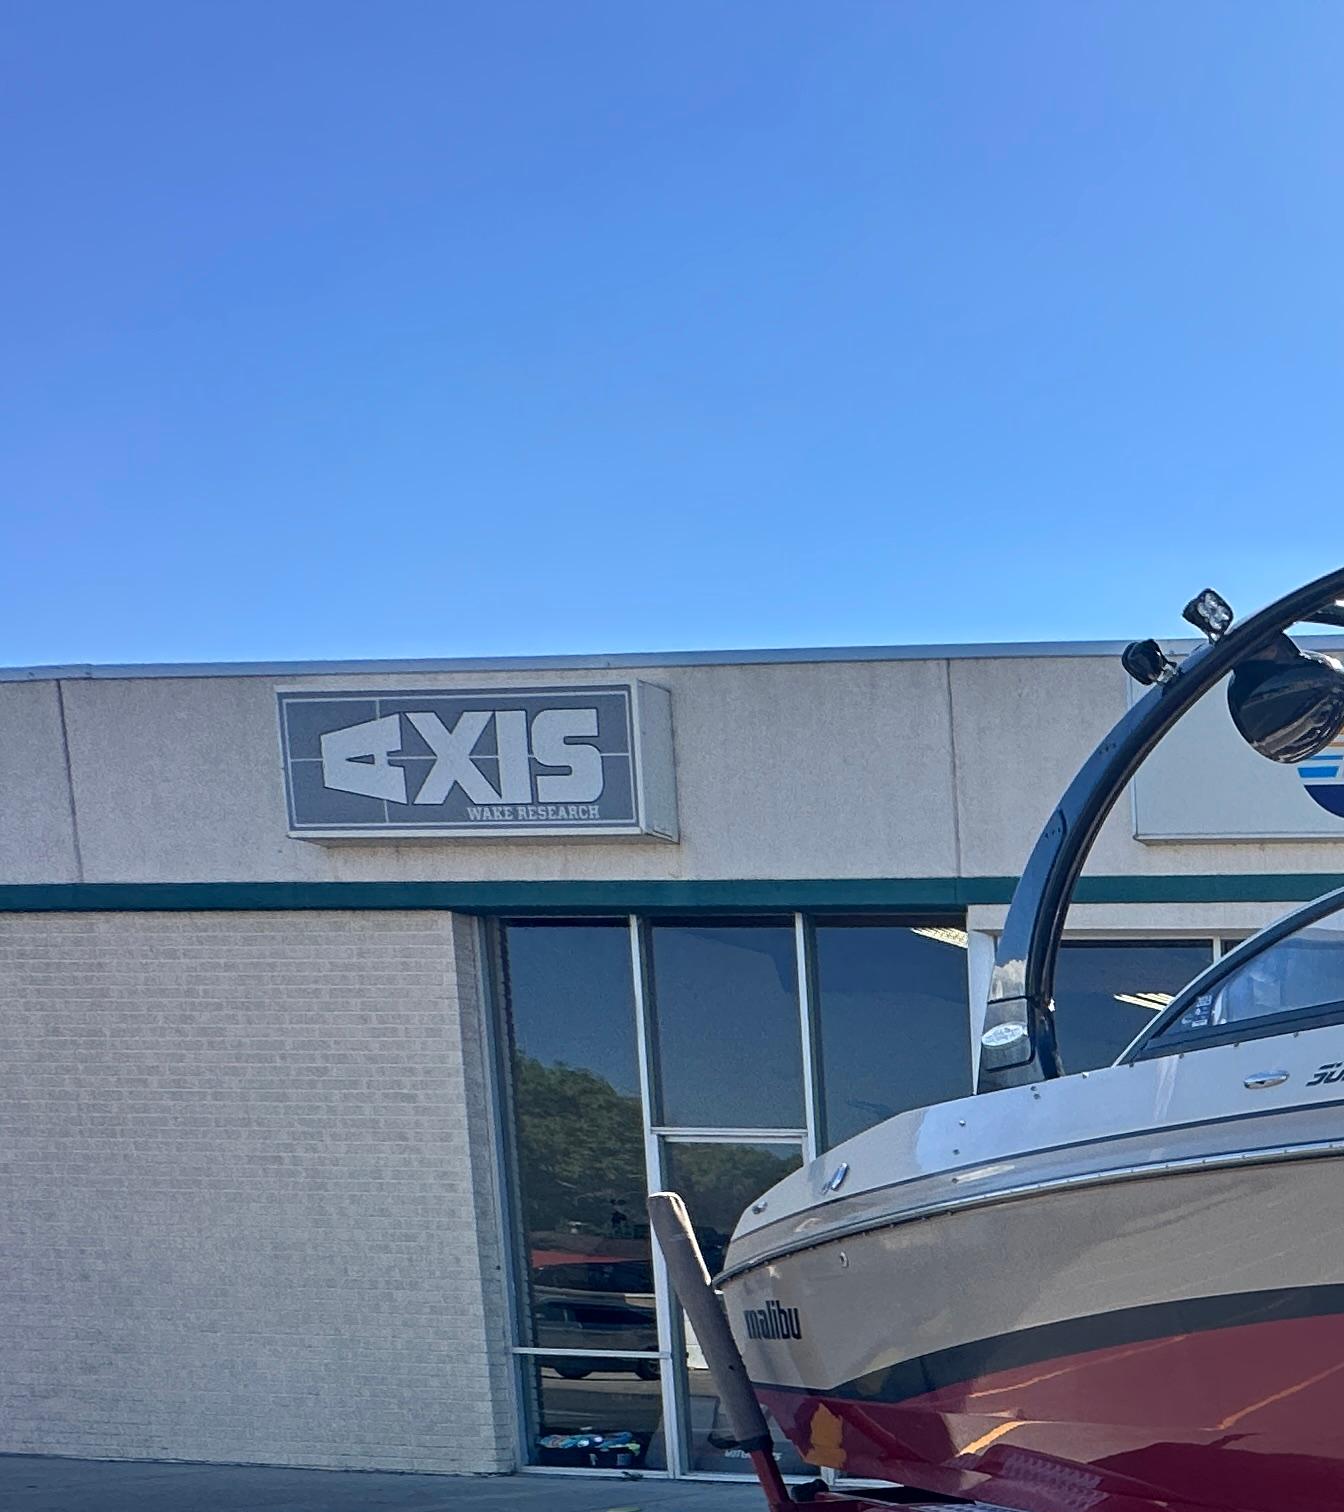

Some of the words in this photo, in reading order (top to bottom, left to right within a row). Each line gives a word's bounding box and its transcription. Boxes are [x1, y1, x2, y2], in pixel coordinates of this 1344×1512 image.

[320, 708, 604, 806] AXIS
[467, 807, 514, 821] WAKE
[518, 805, 601, 820] RESEARCH
[743, 1299, 802, 1340] malibu
